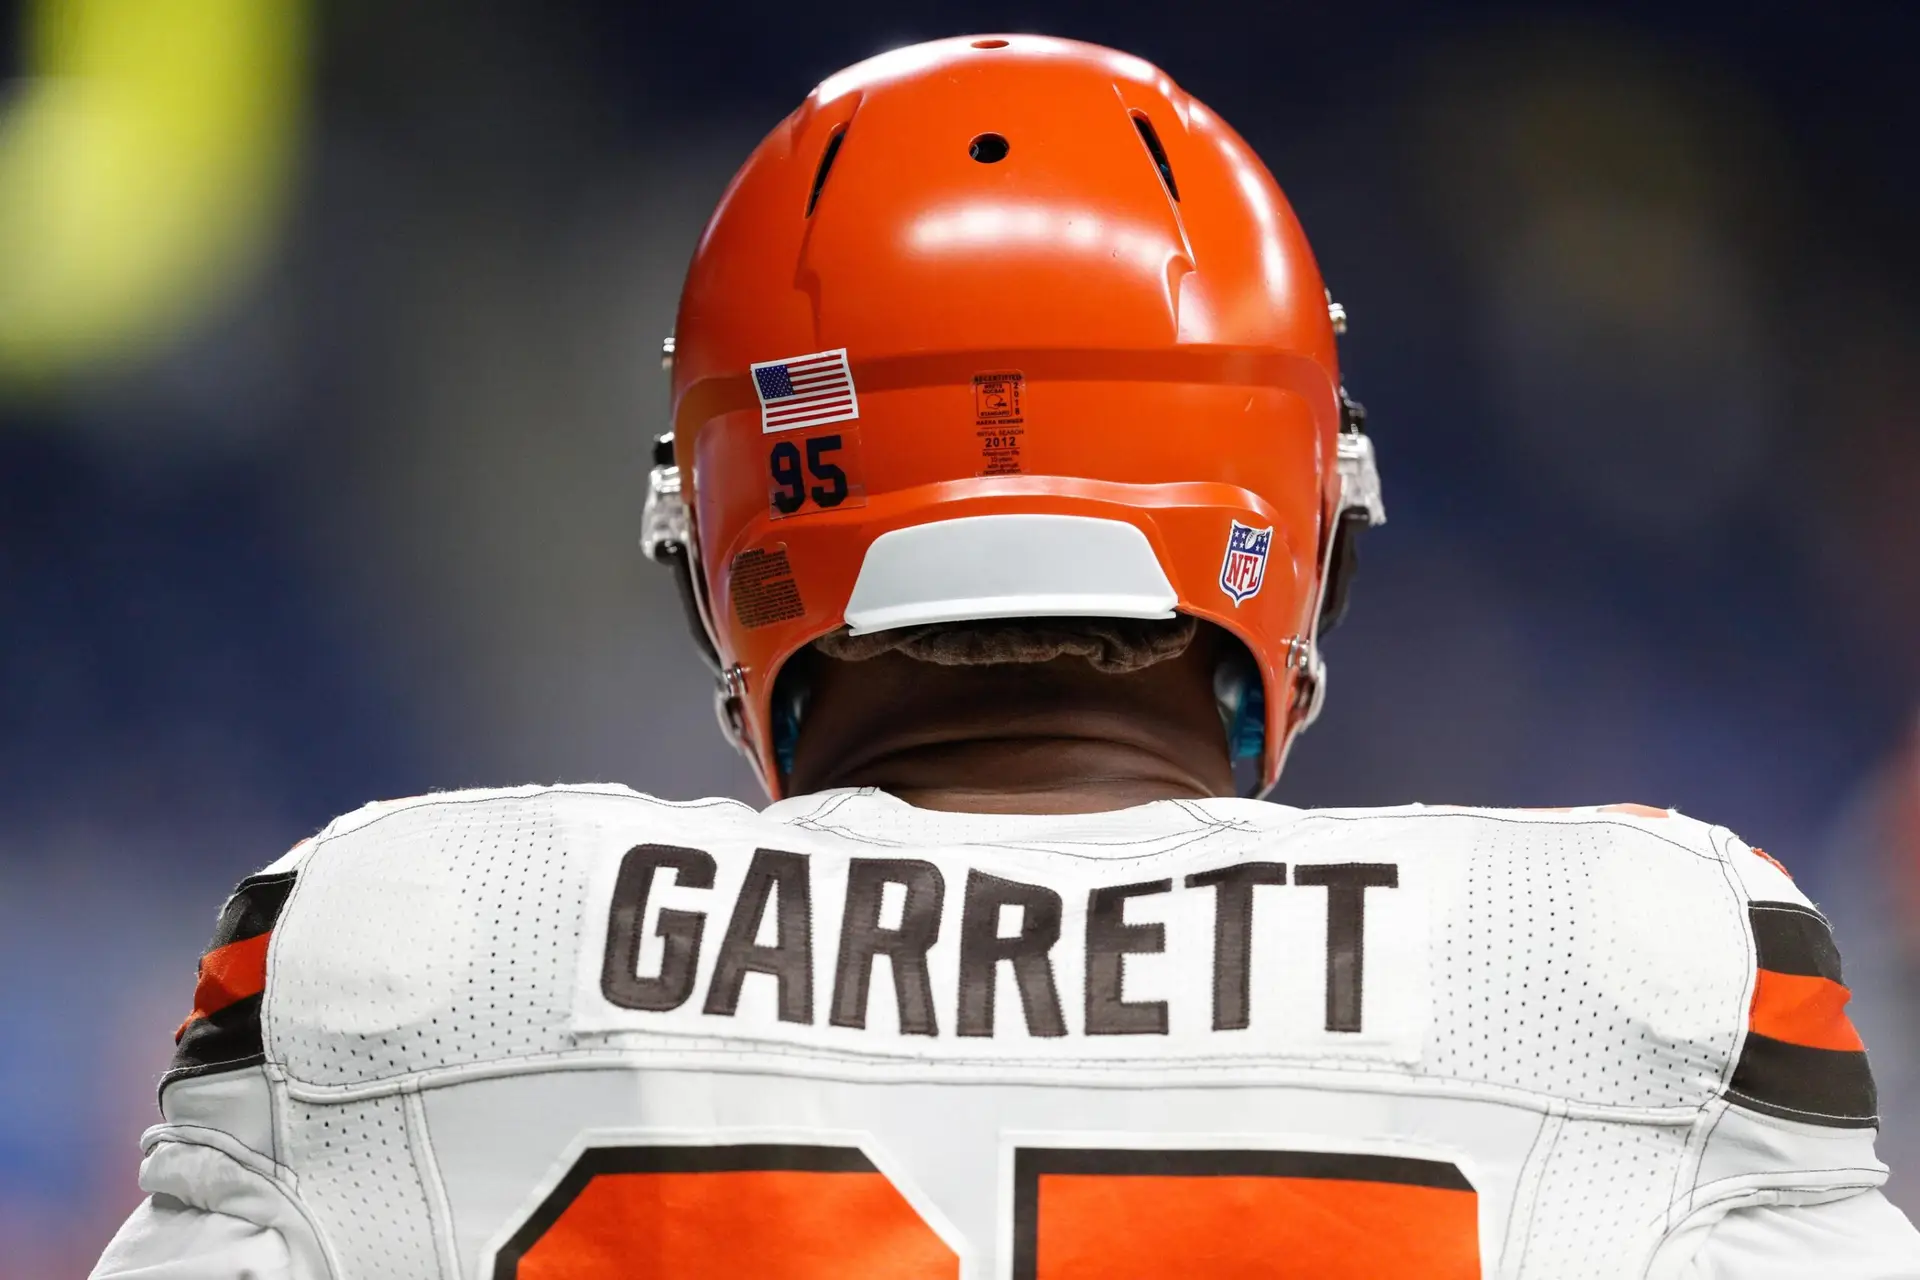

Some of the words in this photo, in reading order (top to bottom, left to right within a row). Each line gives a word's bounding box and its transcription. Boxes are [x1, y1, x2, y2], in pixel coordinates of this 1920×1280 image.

[985, 436, 1016, 448] 2012
[999, 428, 1024, 436] SEASON
[770, 435, 848, 513] 95
[1226, 553, 1258, 591] NFL
[600, 843, 1399, 1037] GARRETT
